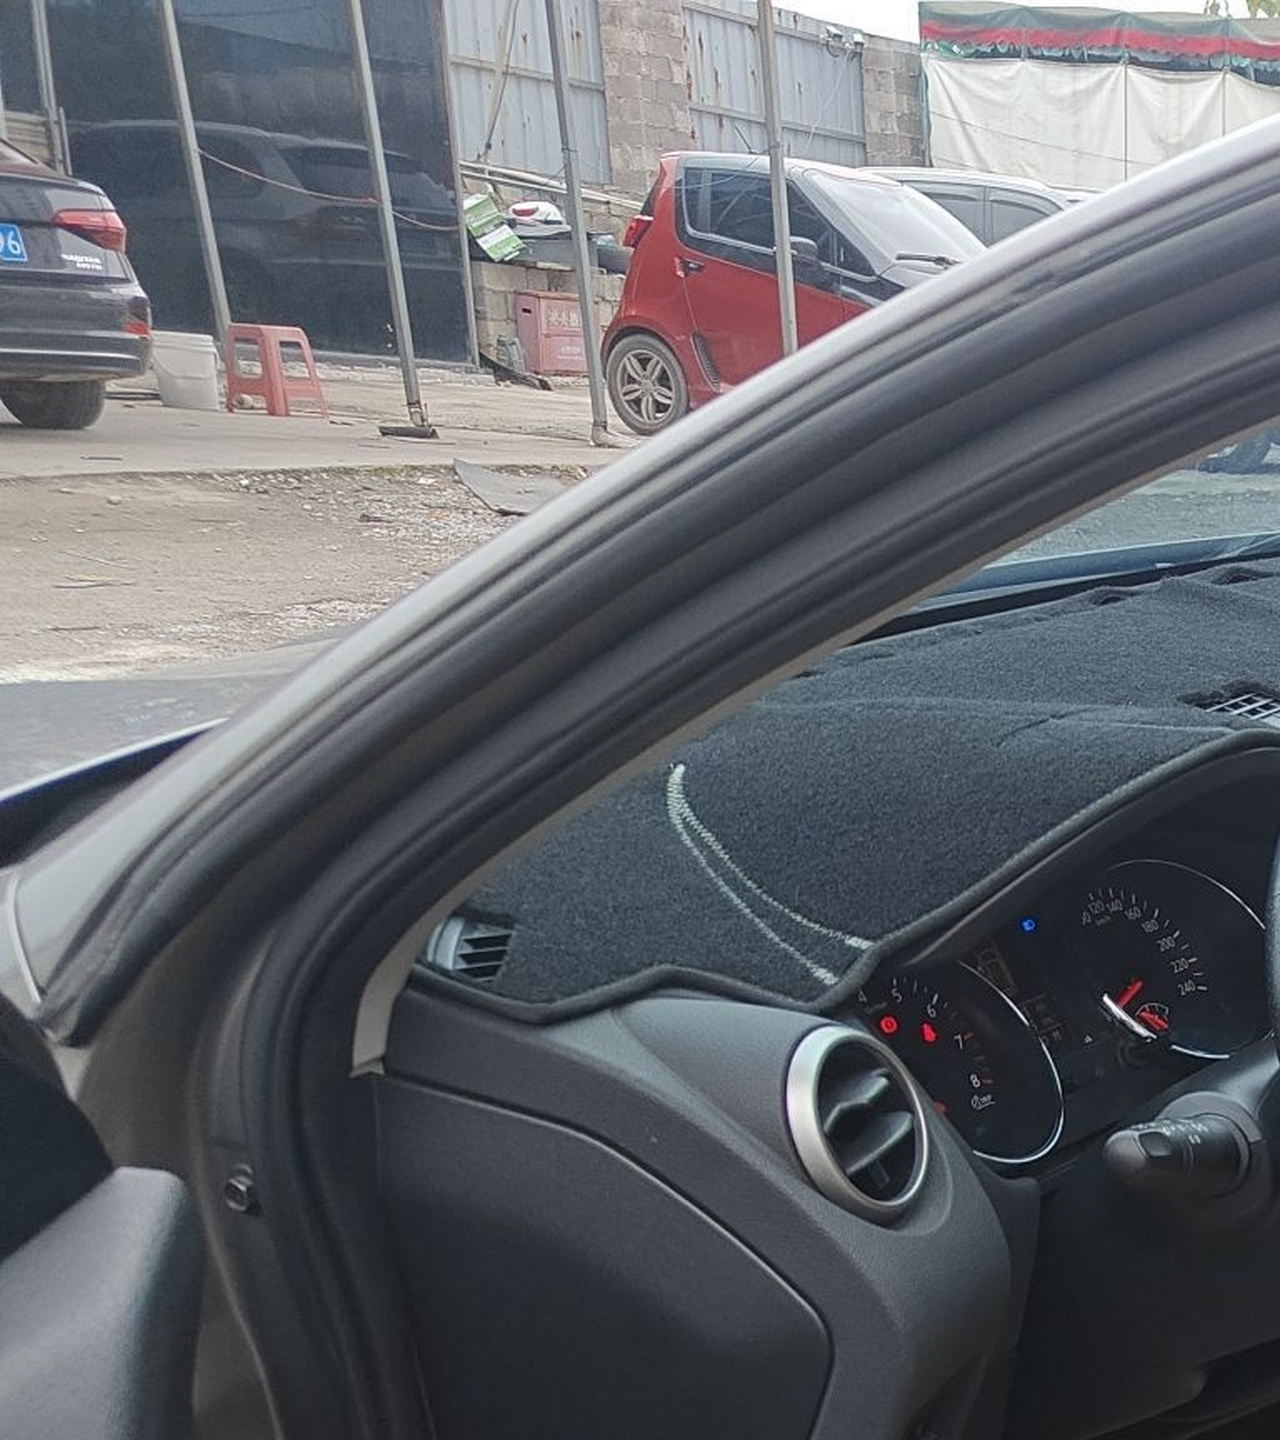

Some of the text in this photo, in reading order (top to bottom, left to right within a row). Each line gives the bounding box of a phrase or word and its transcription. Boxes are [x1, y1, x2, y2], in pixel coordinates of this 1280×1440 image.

[1125, 906, 1142, 920] 160
[1142, 919, 1159, 932] 180
[1157, 937, 1176, 951] 200
[1171, 958, 1189, 973] 220
[891, 987, 903, 1003] 5
[1177, 980, 1196, 996] 240
[926, 1003, 936, 1018] 6
[954, 1034, 963, 1050] 7
[970, 1074, 981, 1088] 8
